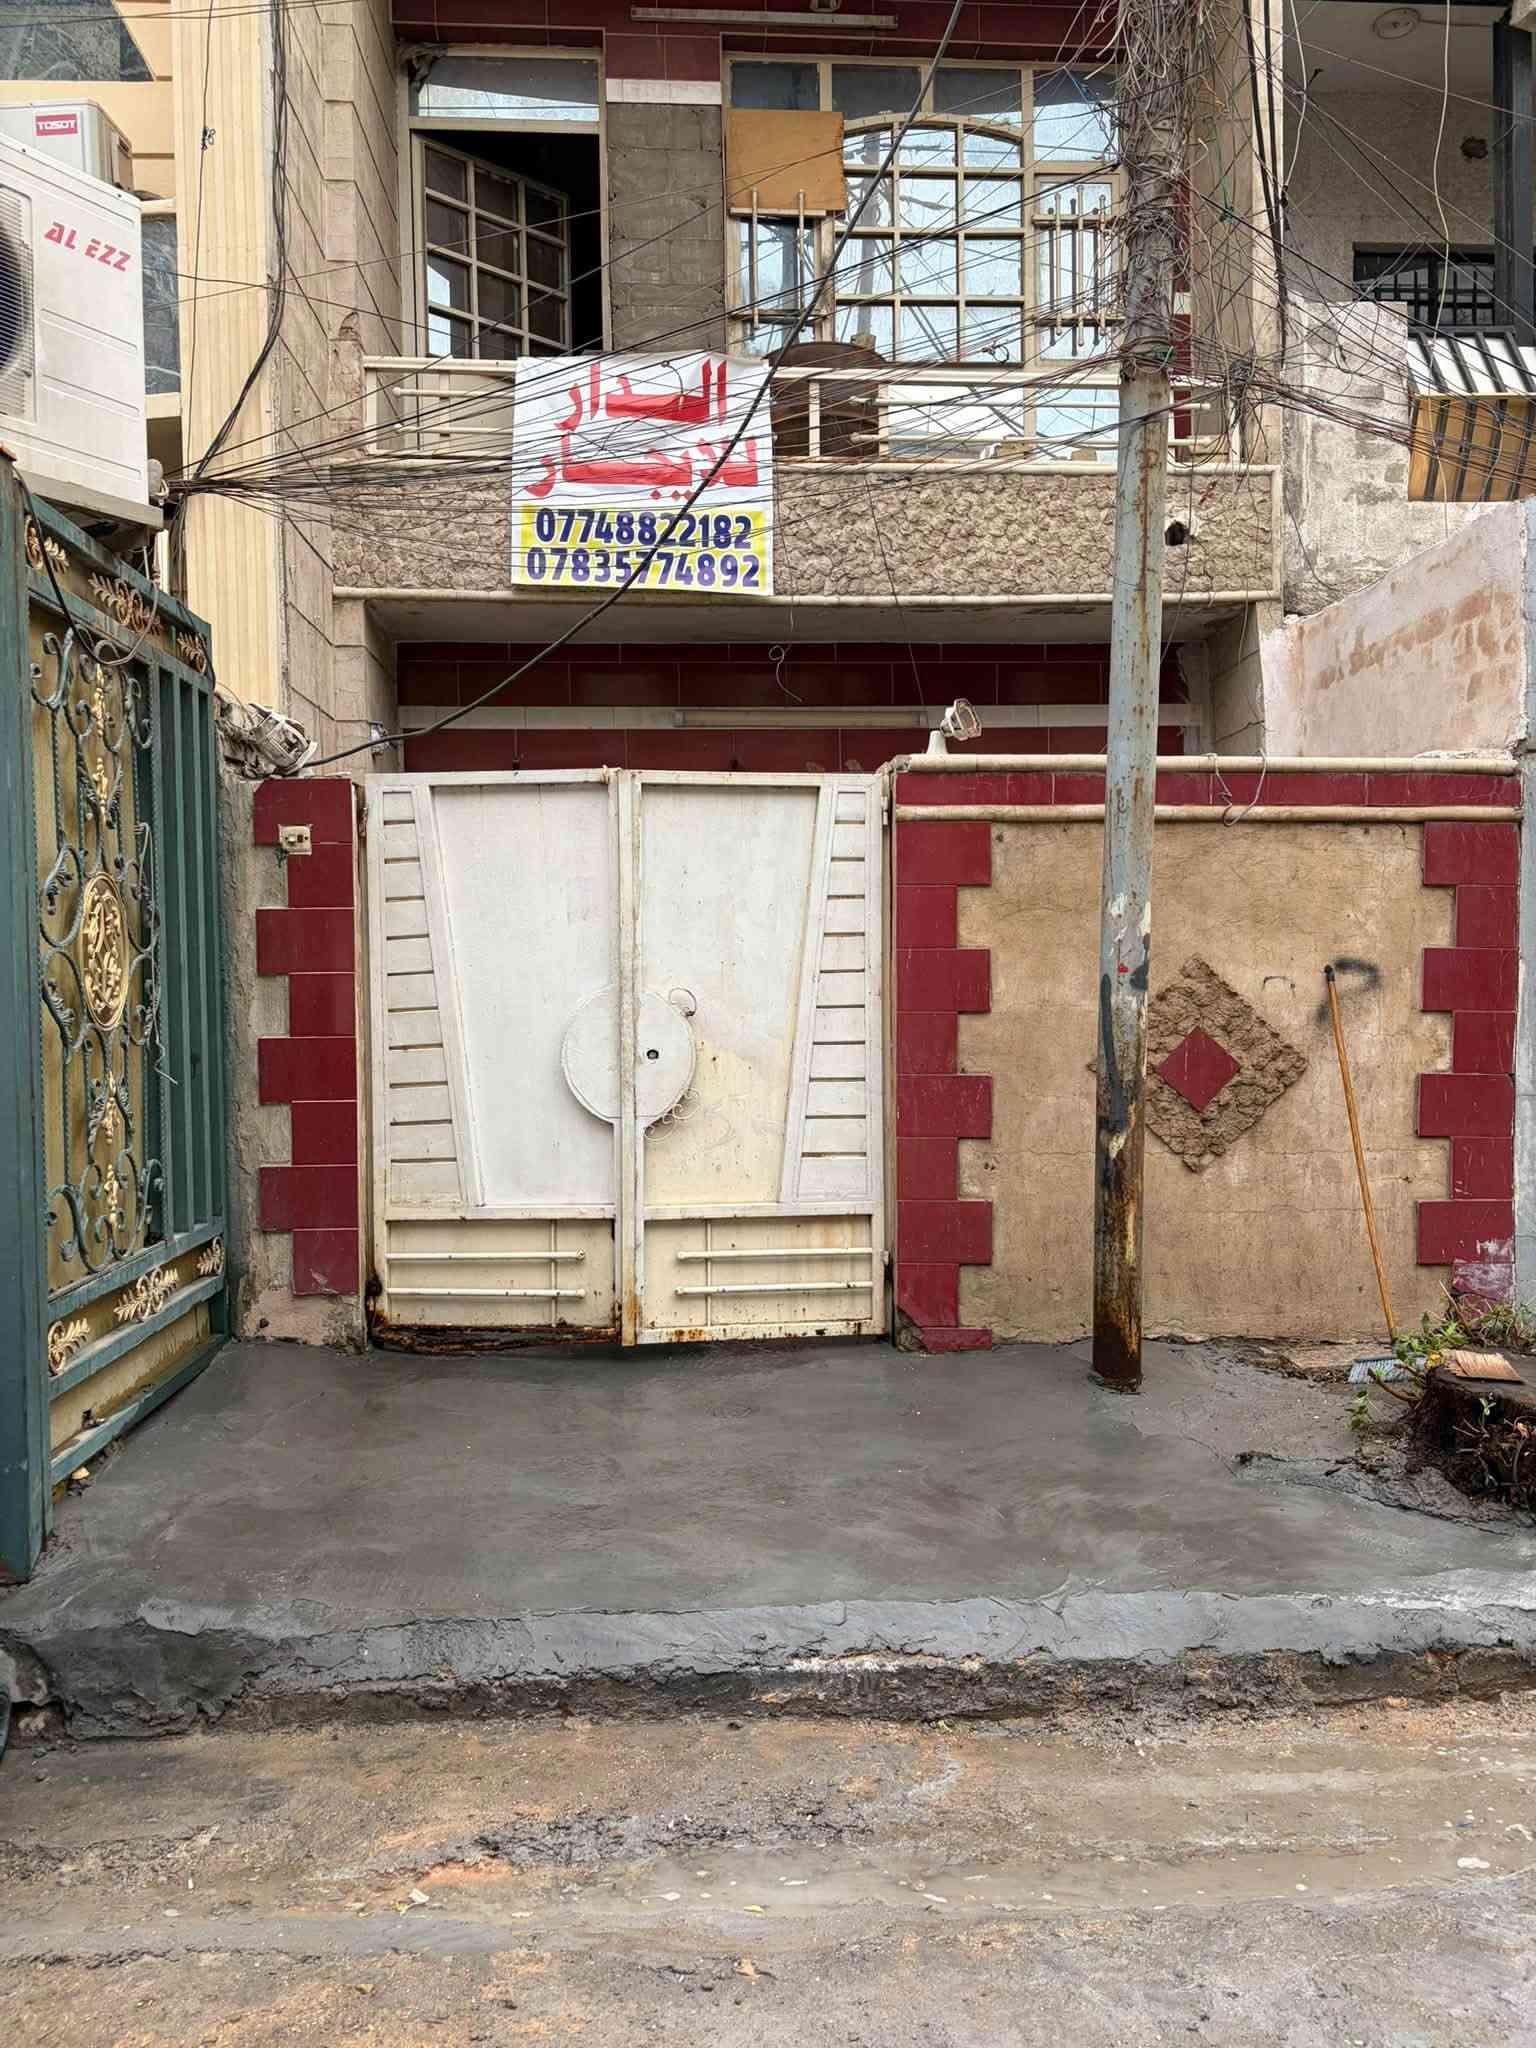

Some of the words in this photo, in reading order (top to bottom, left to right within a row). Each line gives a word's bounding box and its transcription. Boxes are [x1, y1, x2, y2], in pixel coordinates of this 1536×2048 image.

[37, 120, 76, 130] TOSOT
[44, 221, 77, 250] AL
[84, 238, 131, 272] EZZ
[553, 358, 727, 432] الدار
[536, 508, 752, 550] 07748822182
[527, 547, 760, 588] 07835774892
